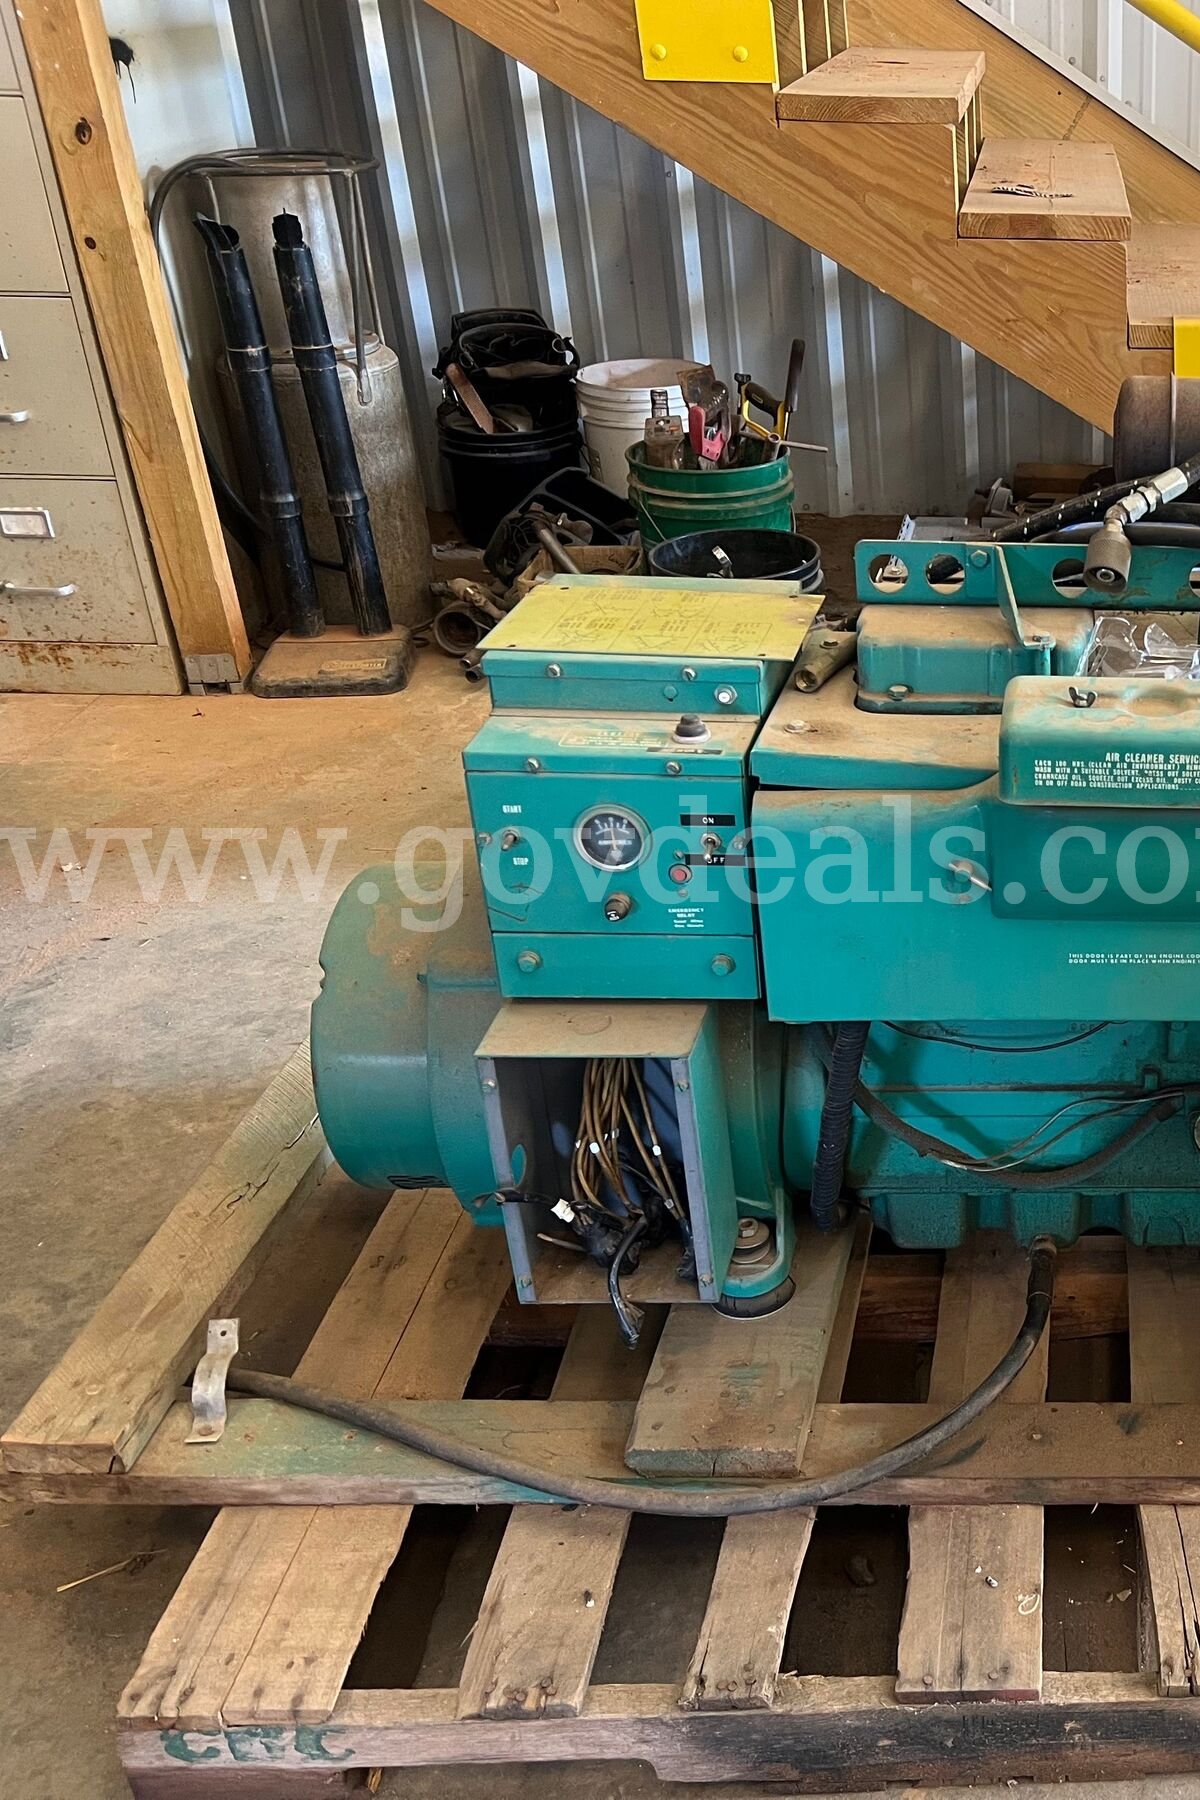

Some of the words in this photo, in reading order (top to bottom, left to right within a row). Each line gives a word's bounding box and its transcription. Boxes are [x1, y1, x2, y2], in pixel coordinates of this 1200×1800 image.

[1105, 753, 1120, 762] AIR
[1125, 753, 1163, 764] CLEANER
[1089, 781, 1133, 789] CONSTRUCTION
[502, 804, 522, 814] START
